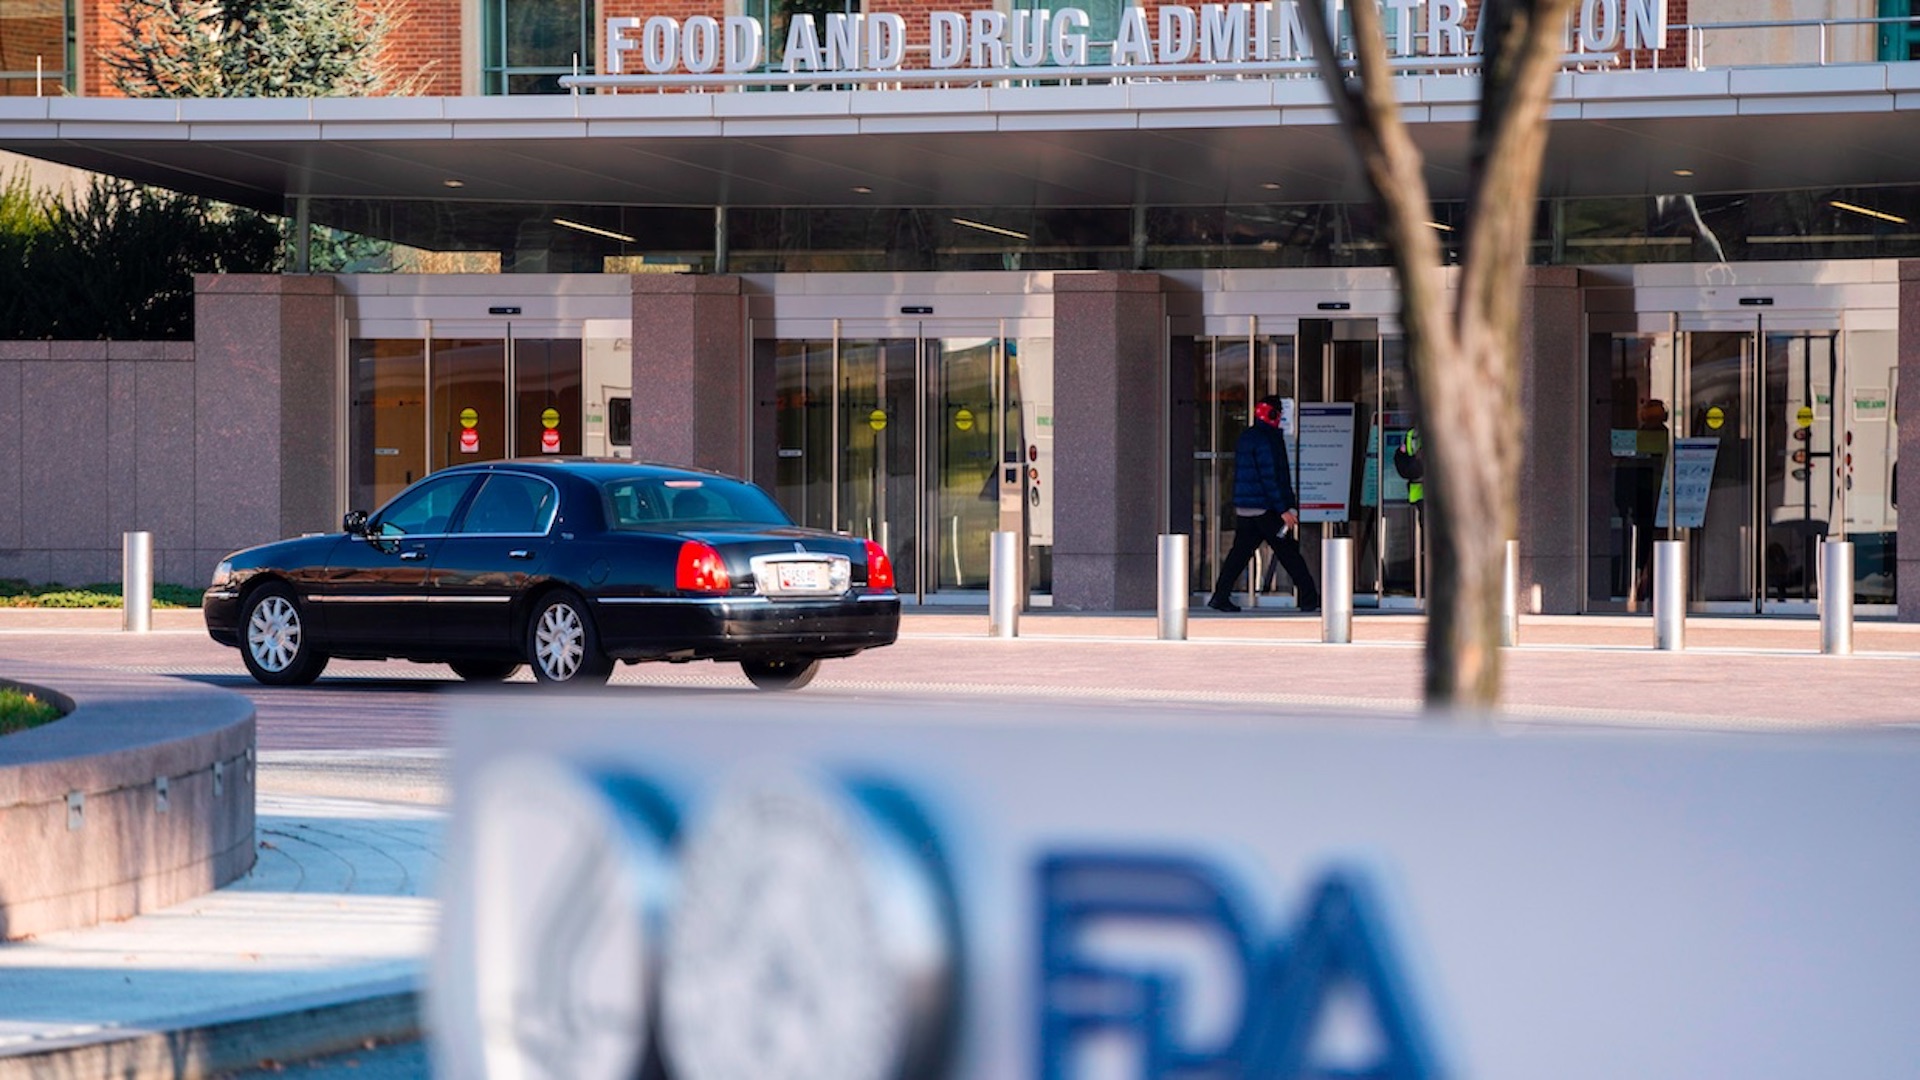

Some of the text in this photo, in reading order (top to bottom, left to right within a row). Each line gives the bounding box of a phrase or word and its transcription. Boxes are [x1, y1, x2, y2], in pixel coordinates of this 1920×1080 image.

[606, 15, 763, 74] FOOD
[781, 12, 906, 72] AND
[929, 8, 1090, 68] DRUG
